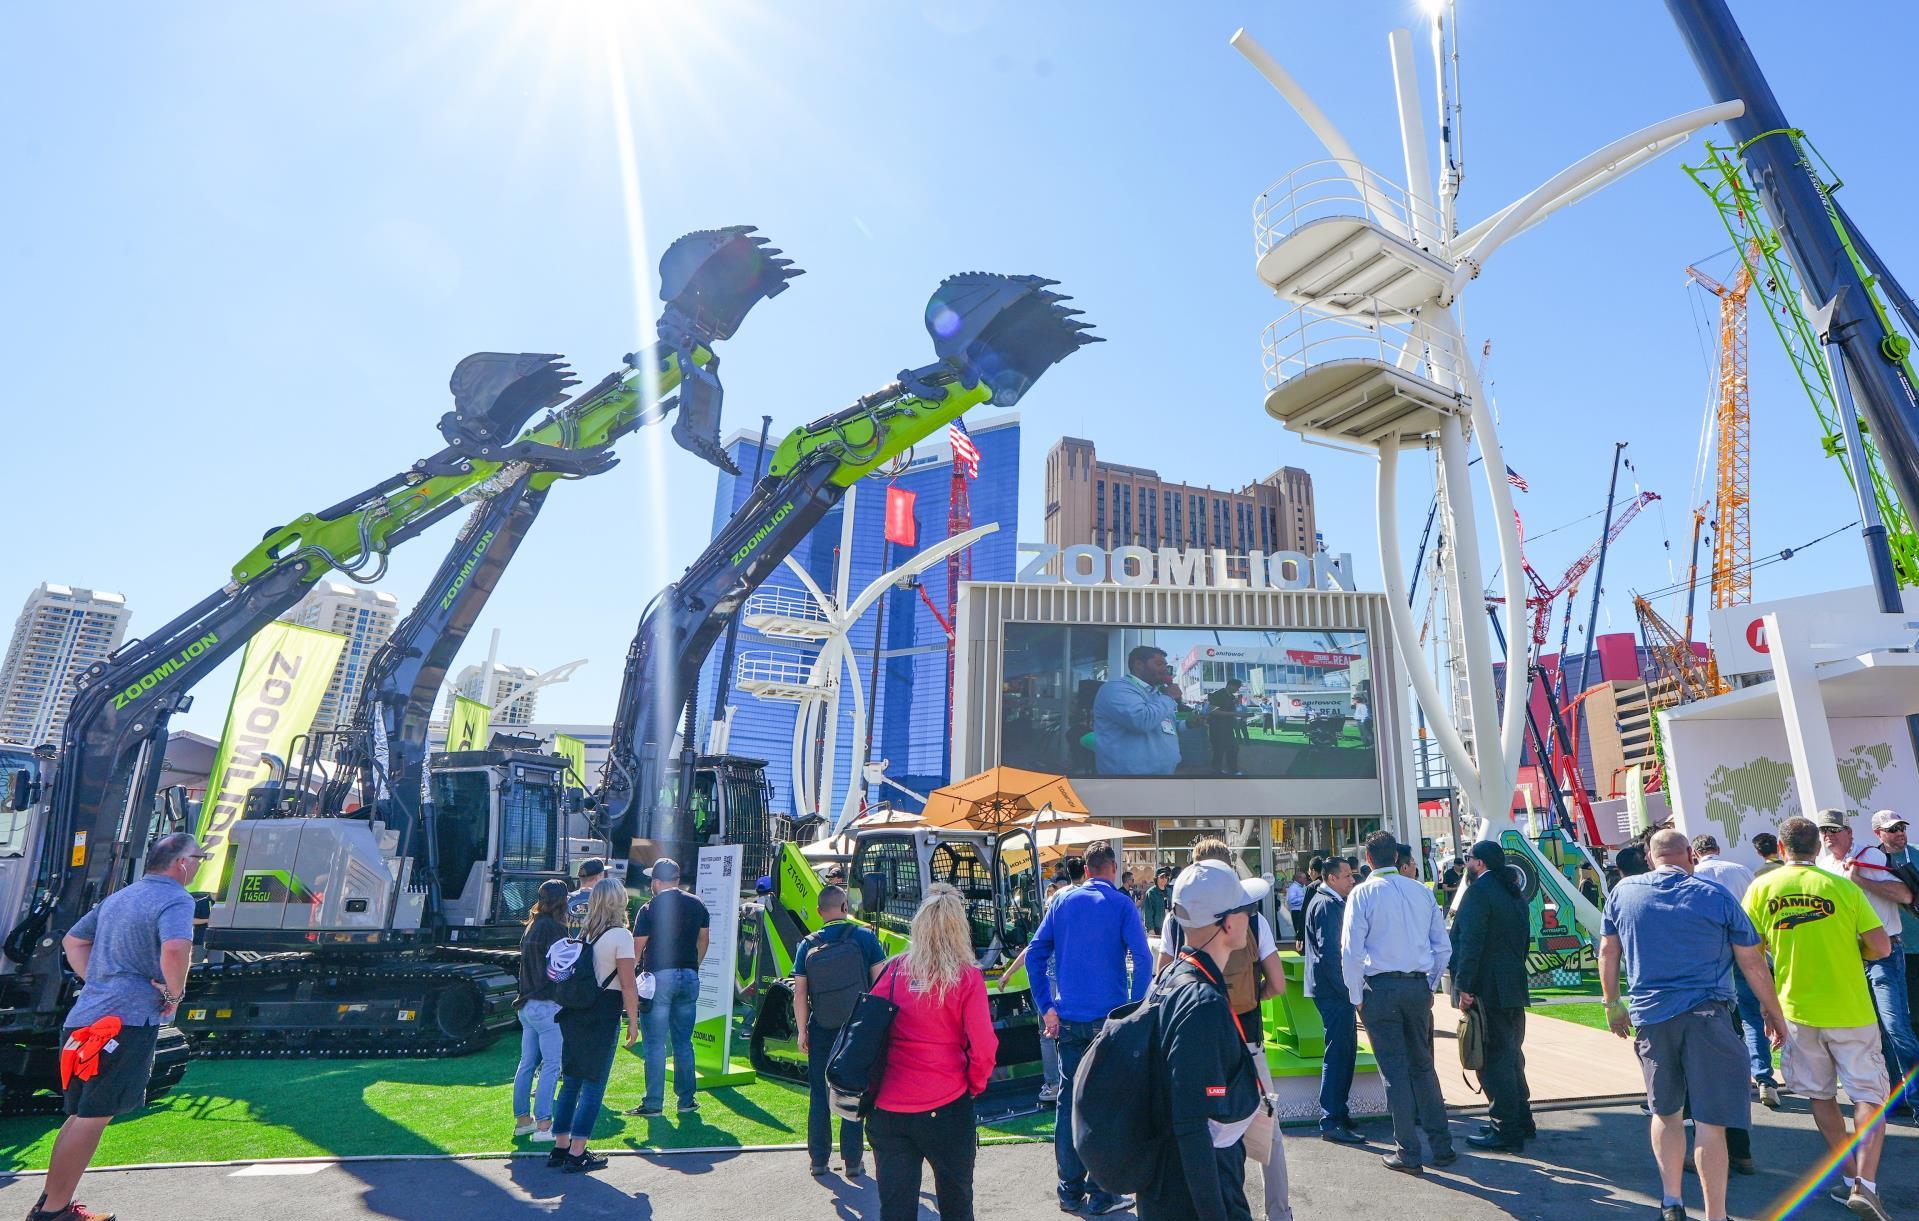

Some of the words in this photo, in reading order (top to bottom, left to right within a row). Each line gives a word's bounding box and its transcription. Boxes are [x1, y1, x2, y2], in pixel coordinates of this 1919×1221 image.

[731, 501, 794, 566] ZOOMLION
[440, 529, 493, 610] ZOOMLION
[1017, 542, 1354, 592] ZOOMLION
[111, 631, 219, 710] ZOOMLION
[201, 650, 302, 862] ZOOMLION
[244, 876, 262, 891] ZE
[244, 892, 270, 902] 145GU
[786, 863, 808, 899] ZT120V
